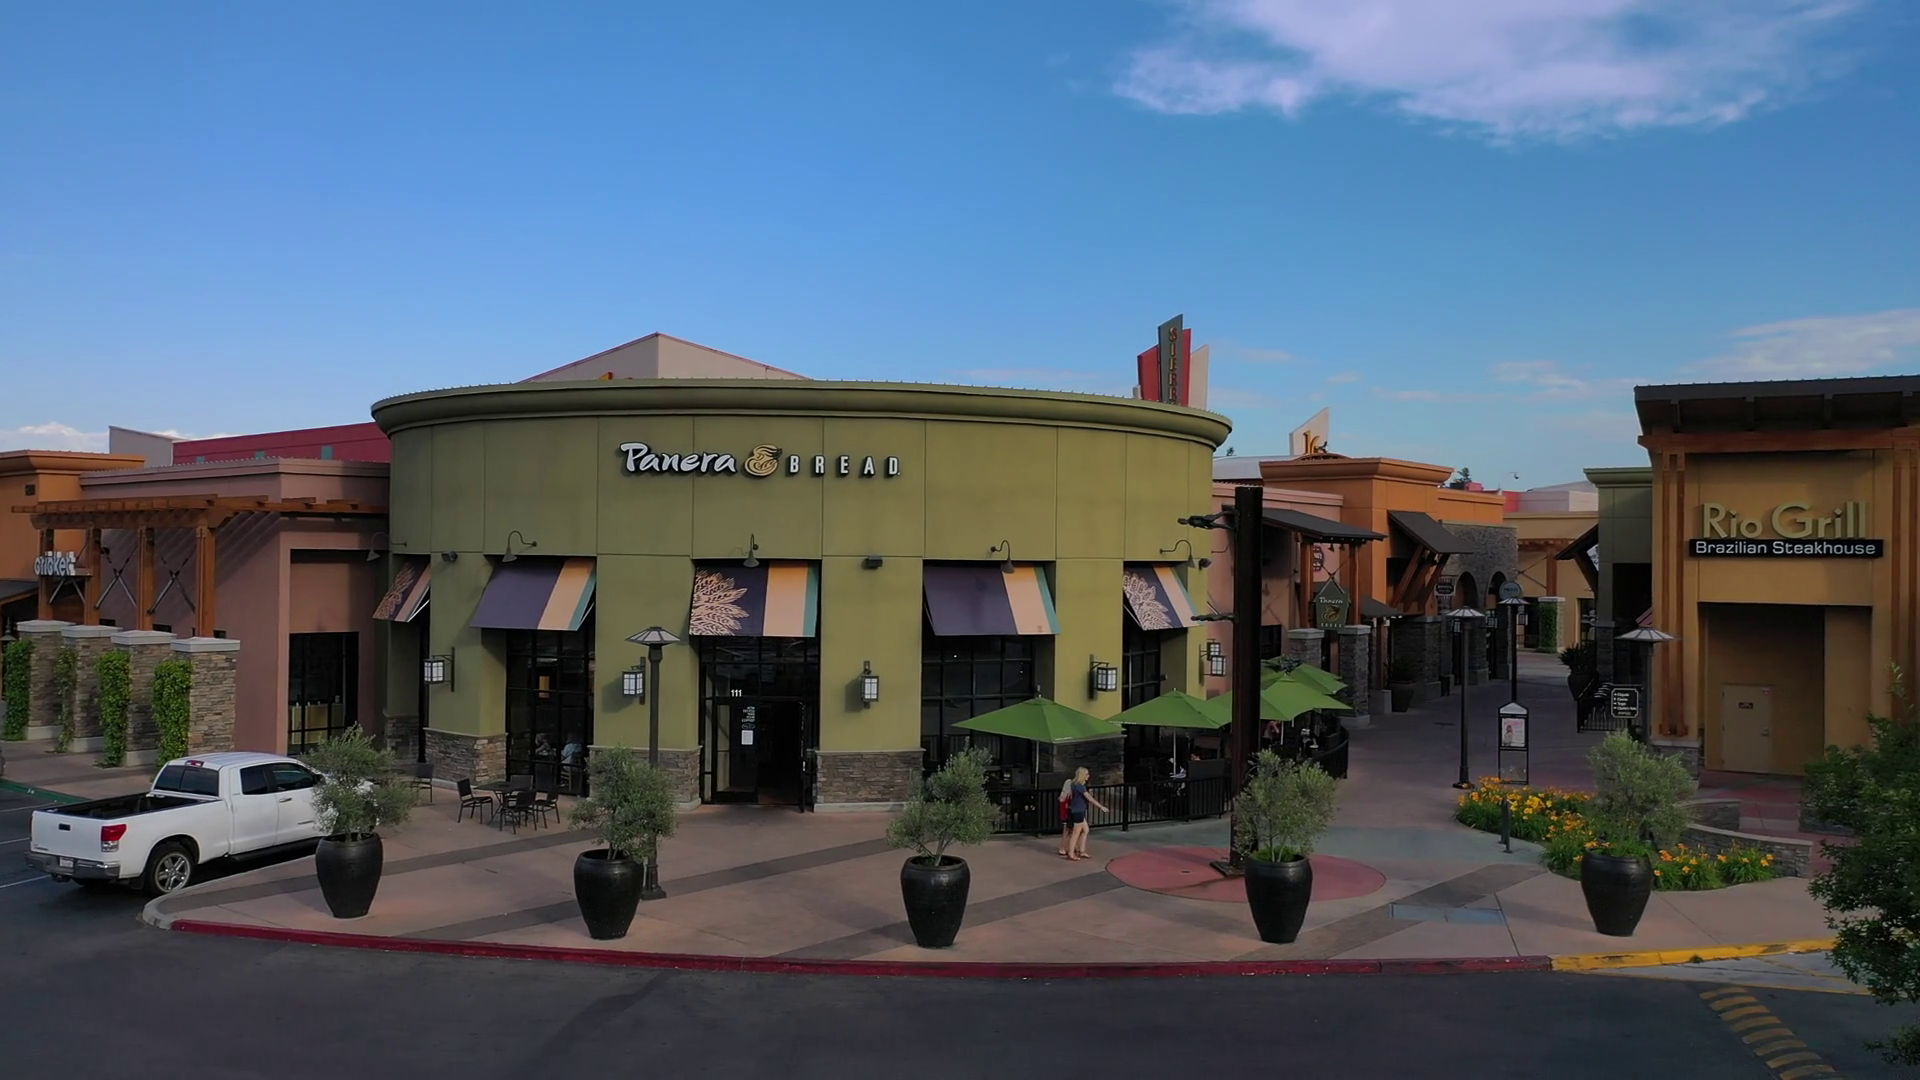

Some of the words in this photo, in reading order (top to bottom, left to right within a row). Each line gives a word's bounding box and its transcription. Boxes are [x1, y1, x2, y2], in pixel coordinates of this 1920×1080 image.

[1168, 327, 1177, 402] SIERR
[620, 442, 737, 474] Panera
[788, 455, 899, 476] BREAD
[1702, 502, 1763, 539] Rio
[1771, 501, 1867, 539] Grill
[1695, 541, 1767, 554] Brazilian
[1772, 541, 1876, 555] Steakhouse
[34, 551, 76, 576] cricket
[730, 689, 742, 697] 111
